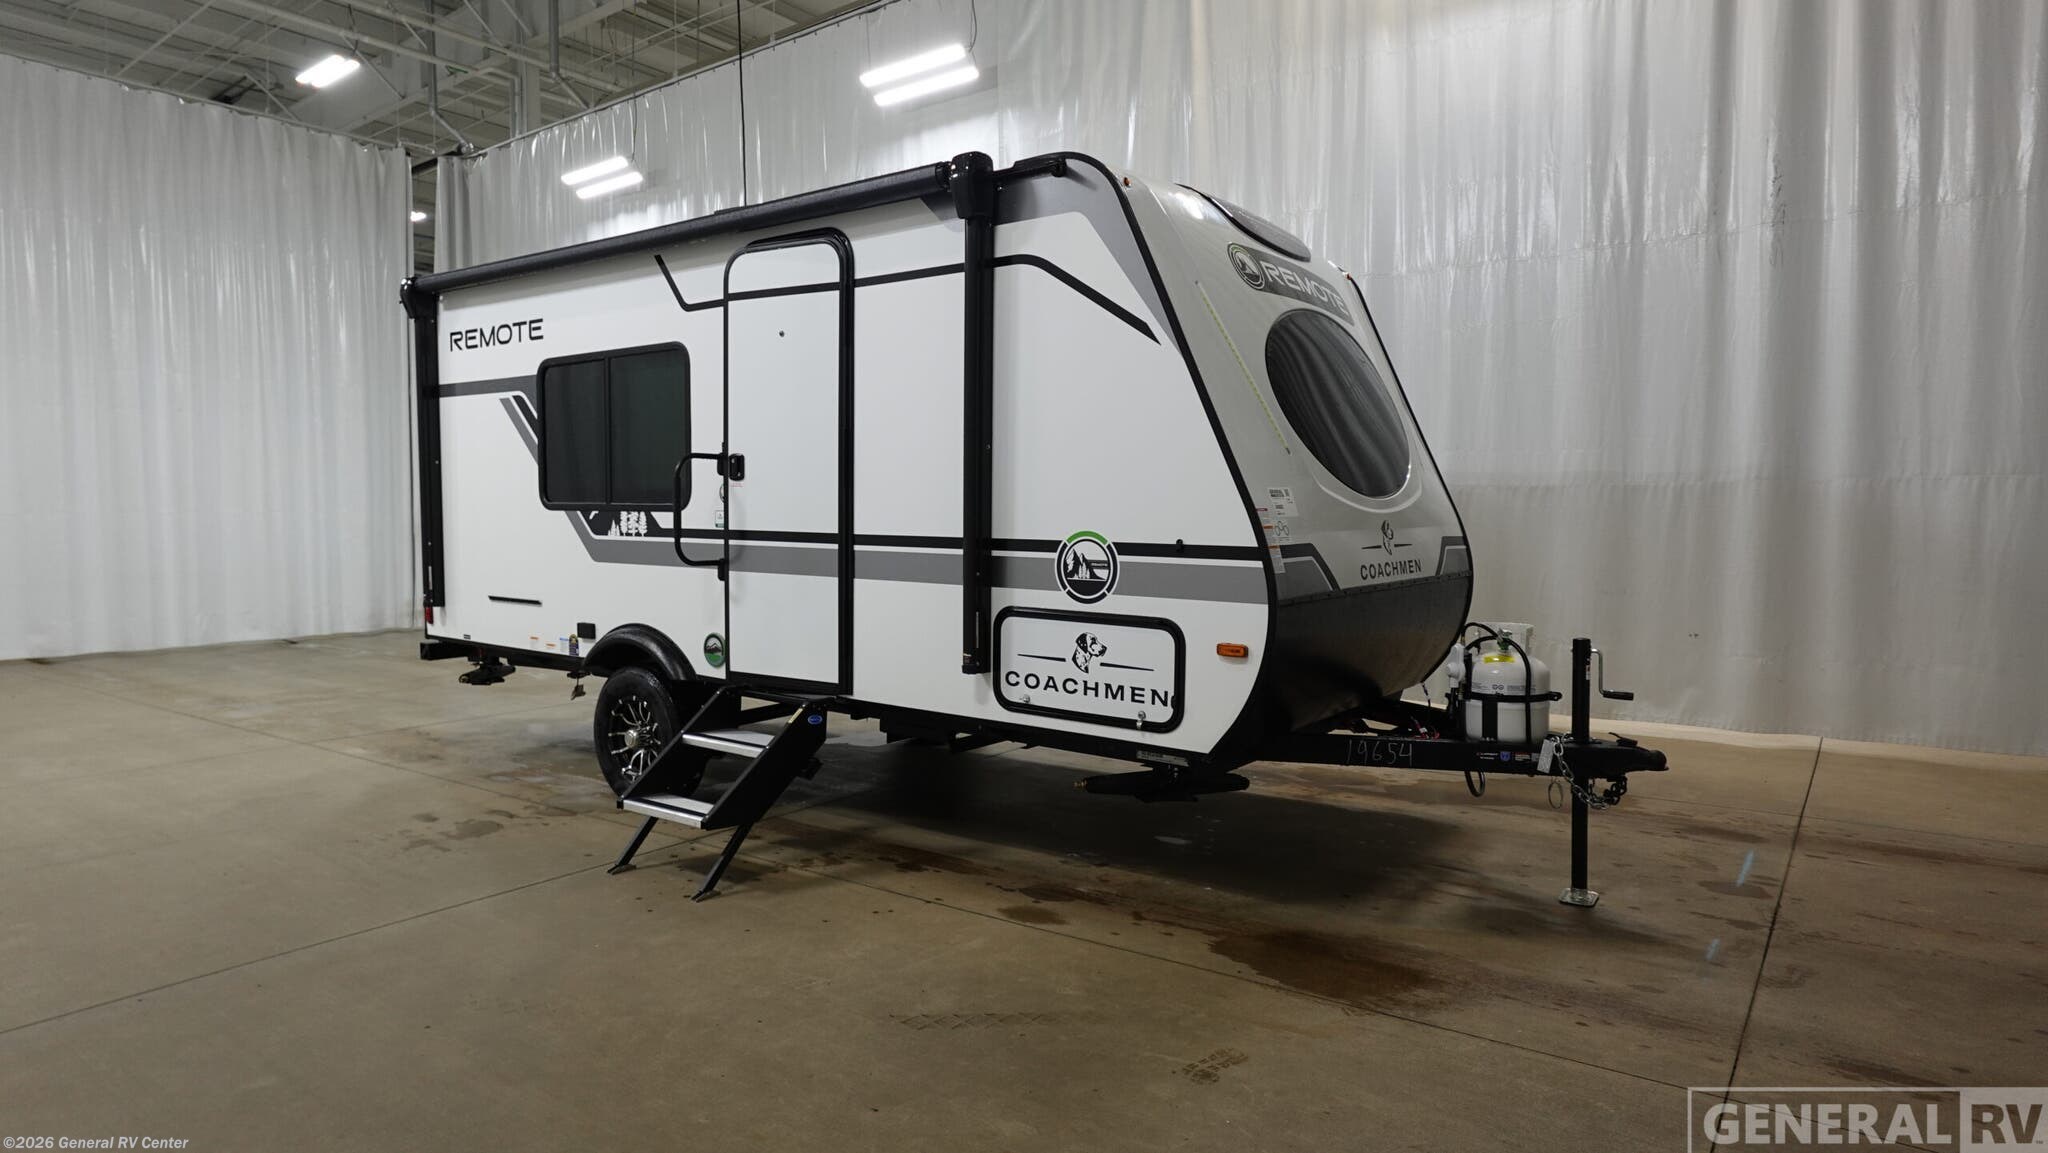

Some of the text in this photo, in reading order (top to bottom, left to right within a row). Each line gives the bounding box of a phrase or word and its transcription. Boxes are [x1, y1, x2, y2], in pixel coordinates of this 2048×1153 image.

[1260, 260, 1349, 315] REMOTE
[450, 318, 543, 352] REMOTE
[1360, 559, 1422, 580] COACHMEN
[1005, 671, 1168, 707] COACHMEN
[1347, 739, 1413, 767] 19654
